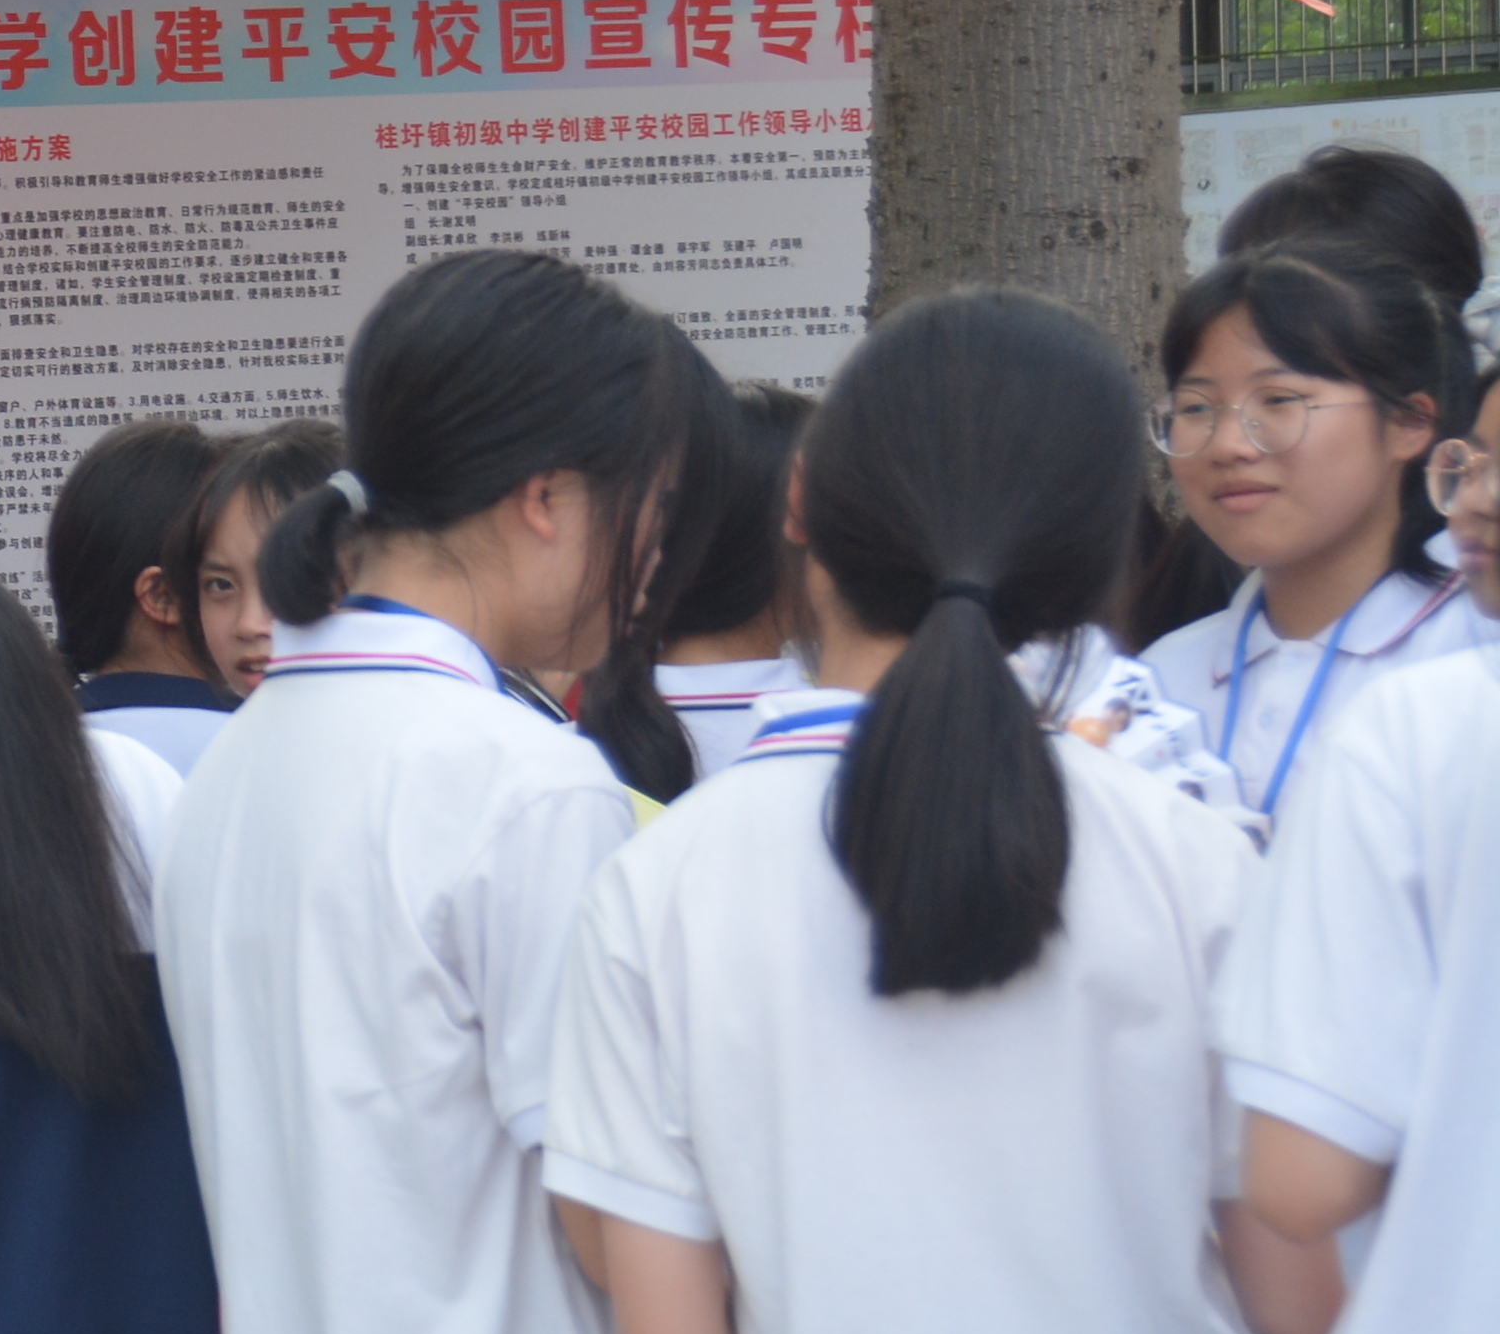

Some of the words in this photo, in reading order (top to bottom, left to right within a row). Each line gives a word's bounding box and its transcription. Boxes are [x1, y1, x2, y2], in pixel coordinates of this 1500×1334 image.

[375, 107, 872, 150] 桂圩镇初级中学创建平安校园工作领导小组
